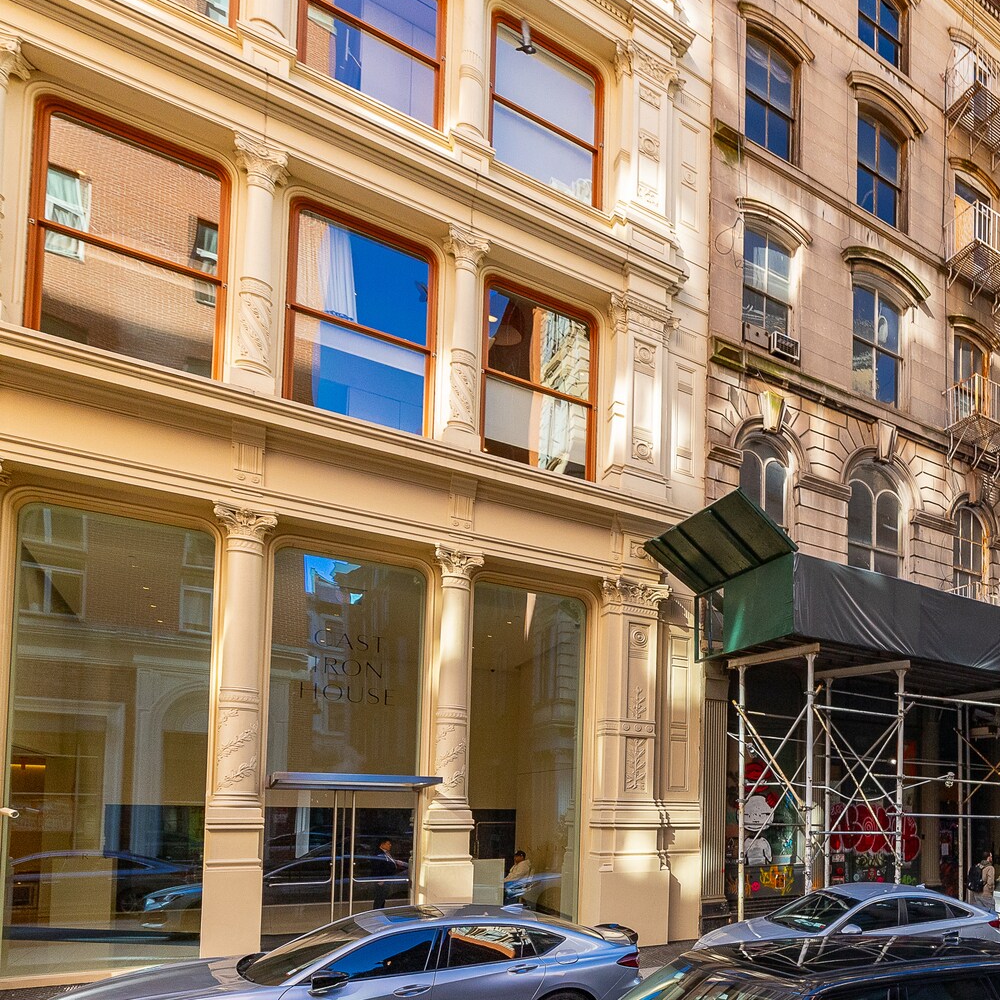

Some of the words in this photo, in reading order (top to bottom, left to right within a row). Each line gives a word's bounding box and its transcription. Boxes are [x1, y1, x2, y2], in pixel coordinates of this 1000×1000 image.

[314, 629, 383, 653] CAST
[314, 655, 383, 679] IRON
[300, 681, 396, 706] HOUSE
